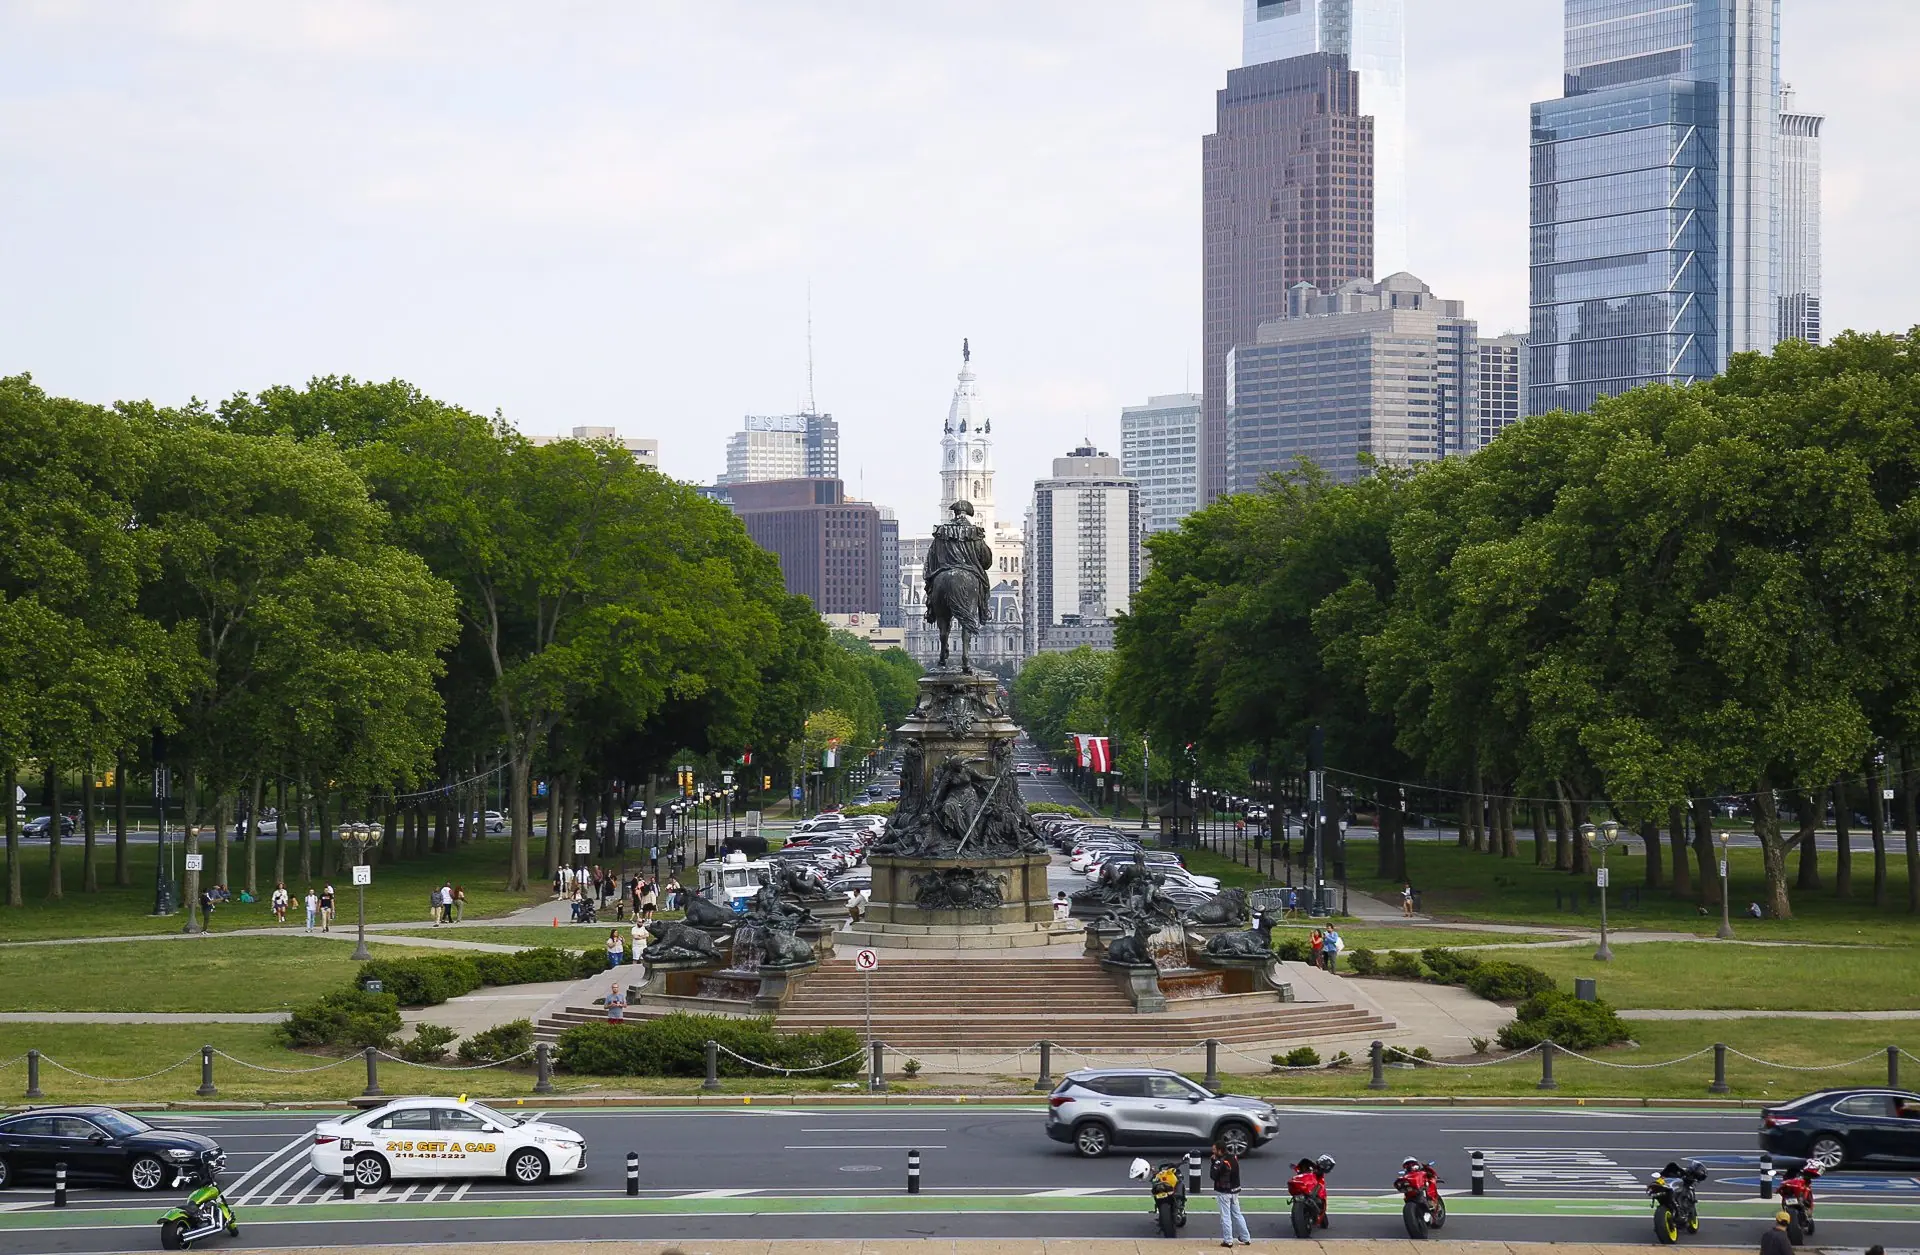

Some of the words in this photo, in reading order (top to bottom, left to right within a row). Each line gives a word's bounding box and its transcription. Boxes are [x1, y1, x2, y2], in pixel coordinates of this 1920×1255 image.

[749, 415, 806, 432] PSFS
[386, 1141, 413, 1151] 215
[417, 1142, 447, 1151] GET
[450, 1143, 462, 1152] A
[465, 1143, 496, 1153] CAB
